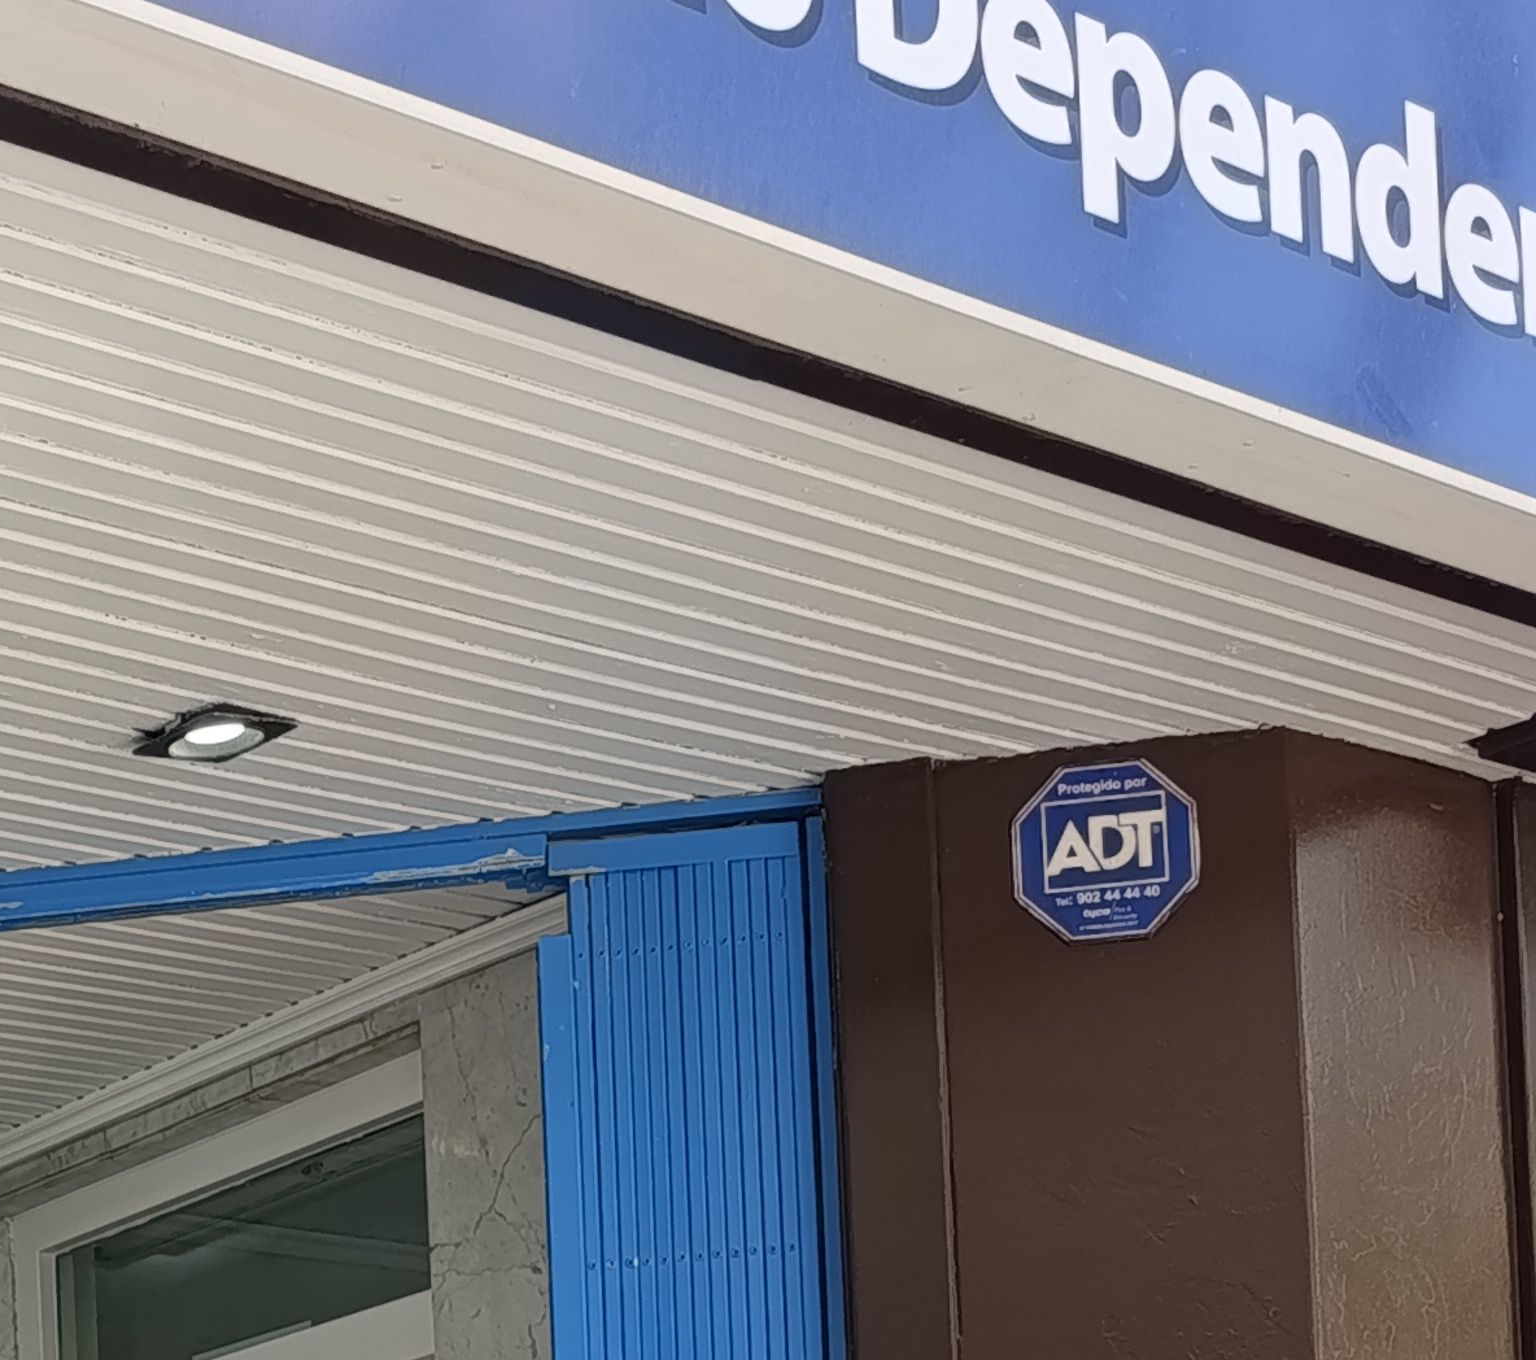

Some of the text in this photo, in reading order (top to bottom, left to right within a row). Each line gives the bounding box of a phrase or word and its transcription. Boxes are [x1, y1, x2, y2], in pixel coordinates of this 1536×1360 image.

[856, 0, 1536, 336] epende
[1057, 777, 1148, 796] Protegido por
[1046, 809, 1164, 877] ADT
[1076, 891, 1101, 905] 902
[1104, 888, 1121, 900] 44
[1123, 886, 1141, 898] 44
[1143, 884, 1161, 897] 40
